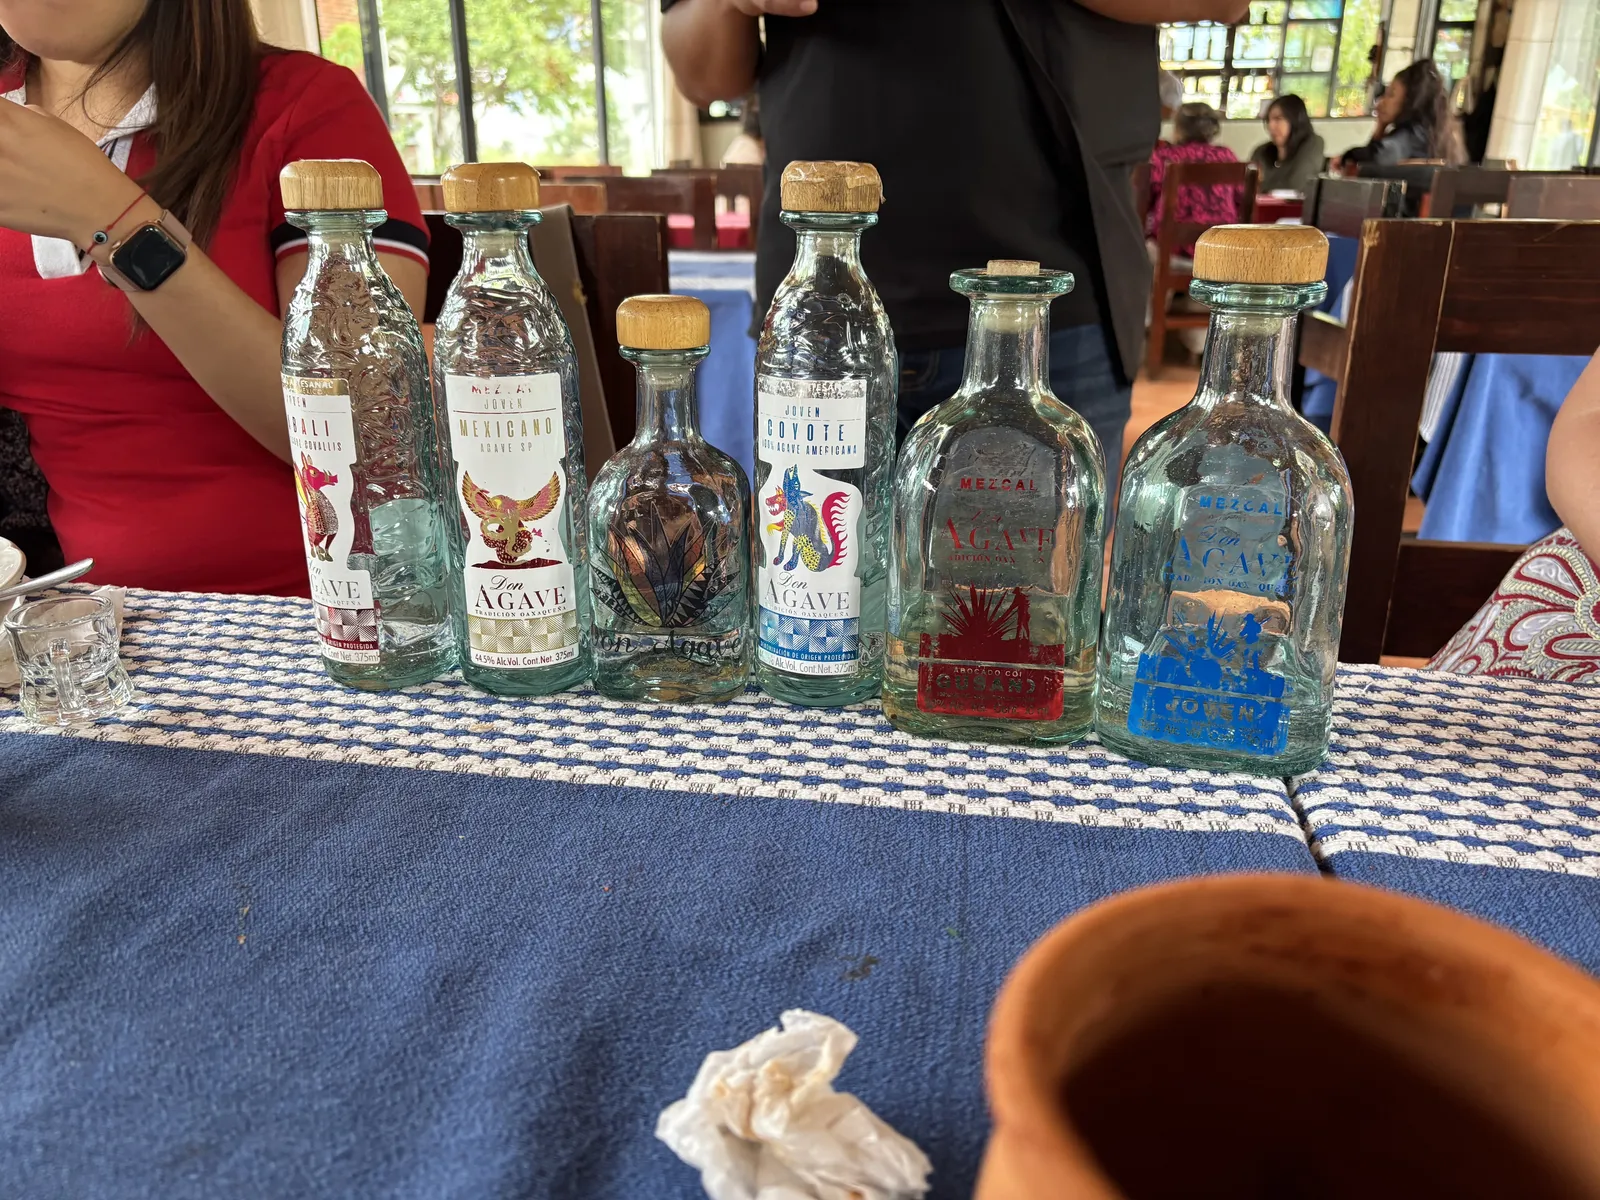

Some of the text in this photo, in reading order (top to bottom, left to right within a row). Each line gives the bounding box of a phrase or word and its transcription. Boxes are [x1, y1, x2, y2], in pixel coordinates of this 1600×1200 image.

[484, 398, 522, 409] JOVEN
[785, 405, 820, 417] JOVEN
[459, 417, 552, 438] MEXICANO
[767, 418, 845, 442] COYOTE
[480, 442, 533, 453] AGAVE SP
[777, 442, 800, 455] AGAVE
[806, 445, 857, 456] AMERICANA
[960, 478, 1038, 491] MEZCAL
[1199, 495, 1283, 516] MEZCAL
[940, 516, 1055, 552] AGAVE
[310, 573, 361, 599] GAVE
[489, 575, 524, 591] Don
[777, 571, 808, 590] Don
[475, 584, 567, 611] AGAVE
[765, 577, 850, 611] AGAVE
[475, 609, 517, 618] TRADICIÓN
[801, 610, 850, 619] OAXAQUEÑA
[343, 642, 374, 650] PROTEGIDA
[953, 666, 1001, 676] ABOCADO
[935, 673, 1036, 695] GUSANO
[1166, 696, 1255, 722] JOVEN
